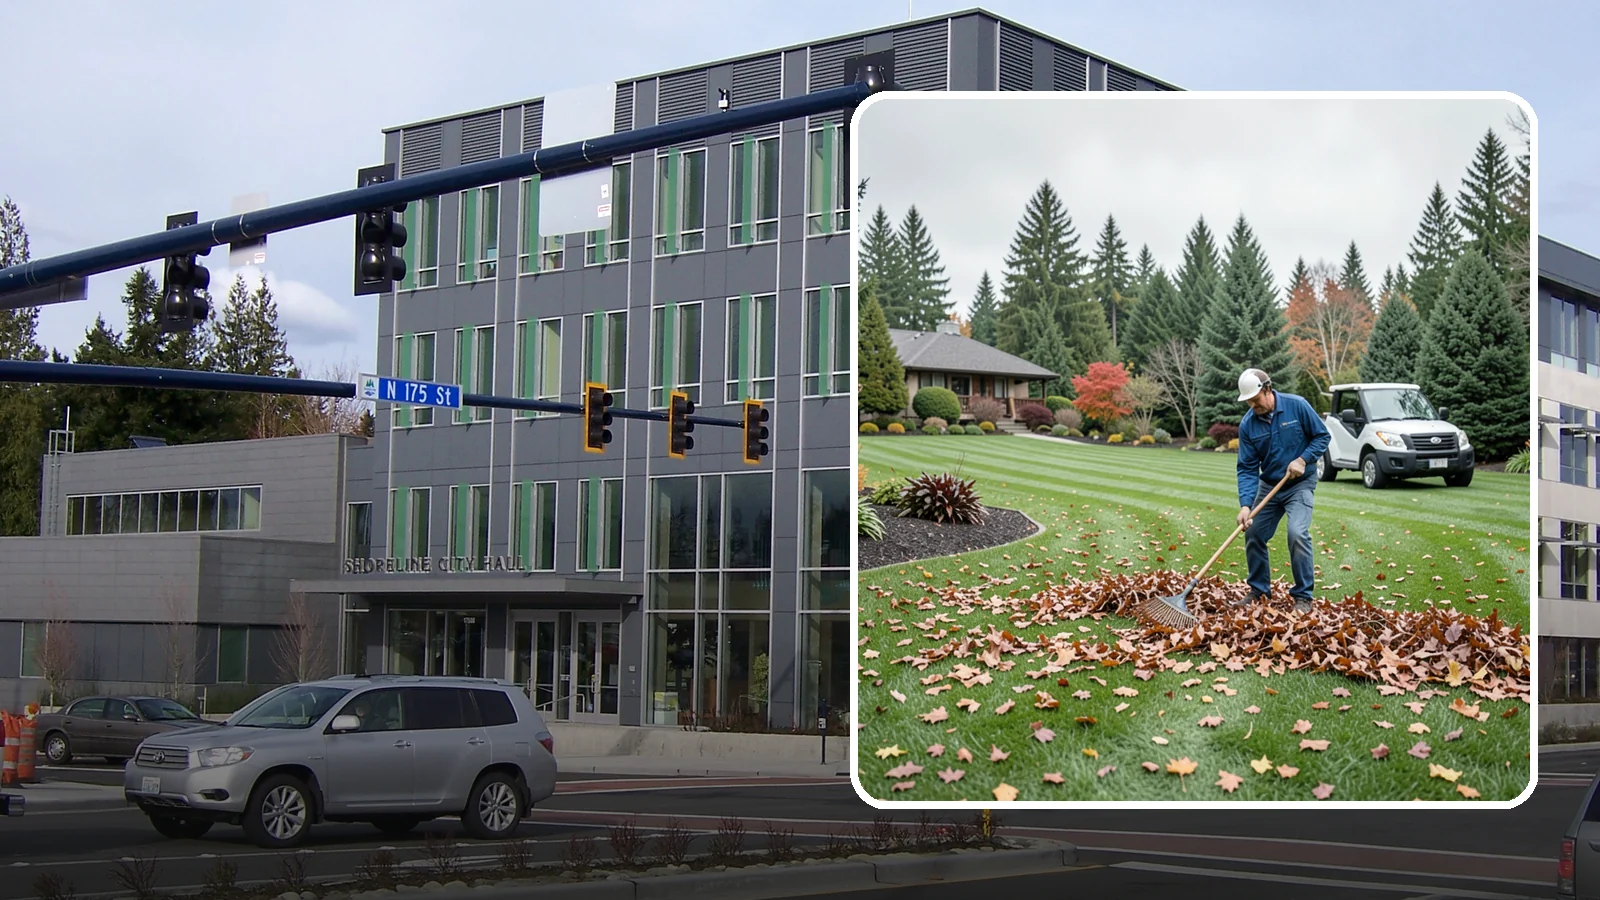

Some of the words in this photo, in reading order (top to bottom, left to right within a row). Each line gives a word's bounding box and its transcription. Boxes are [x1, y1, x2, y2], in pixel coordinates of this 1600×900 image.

[387, 380, 396, 399] N
[405, 382, 427, 403] 175
[436, 386, 451, 405] St
[343, 557, 431, 574] SHORELINE
[438, 556, 474, 572] CITY
[484, 556, 525, 572] HALL
